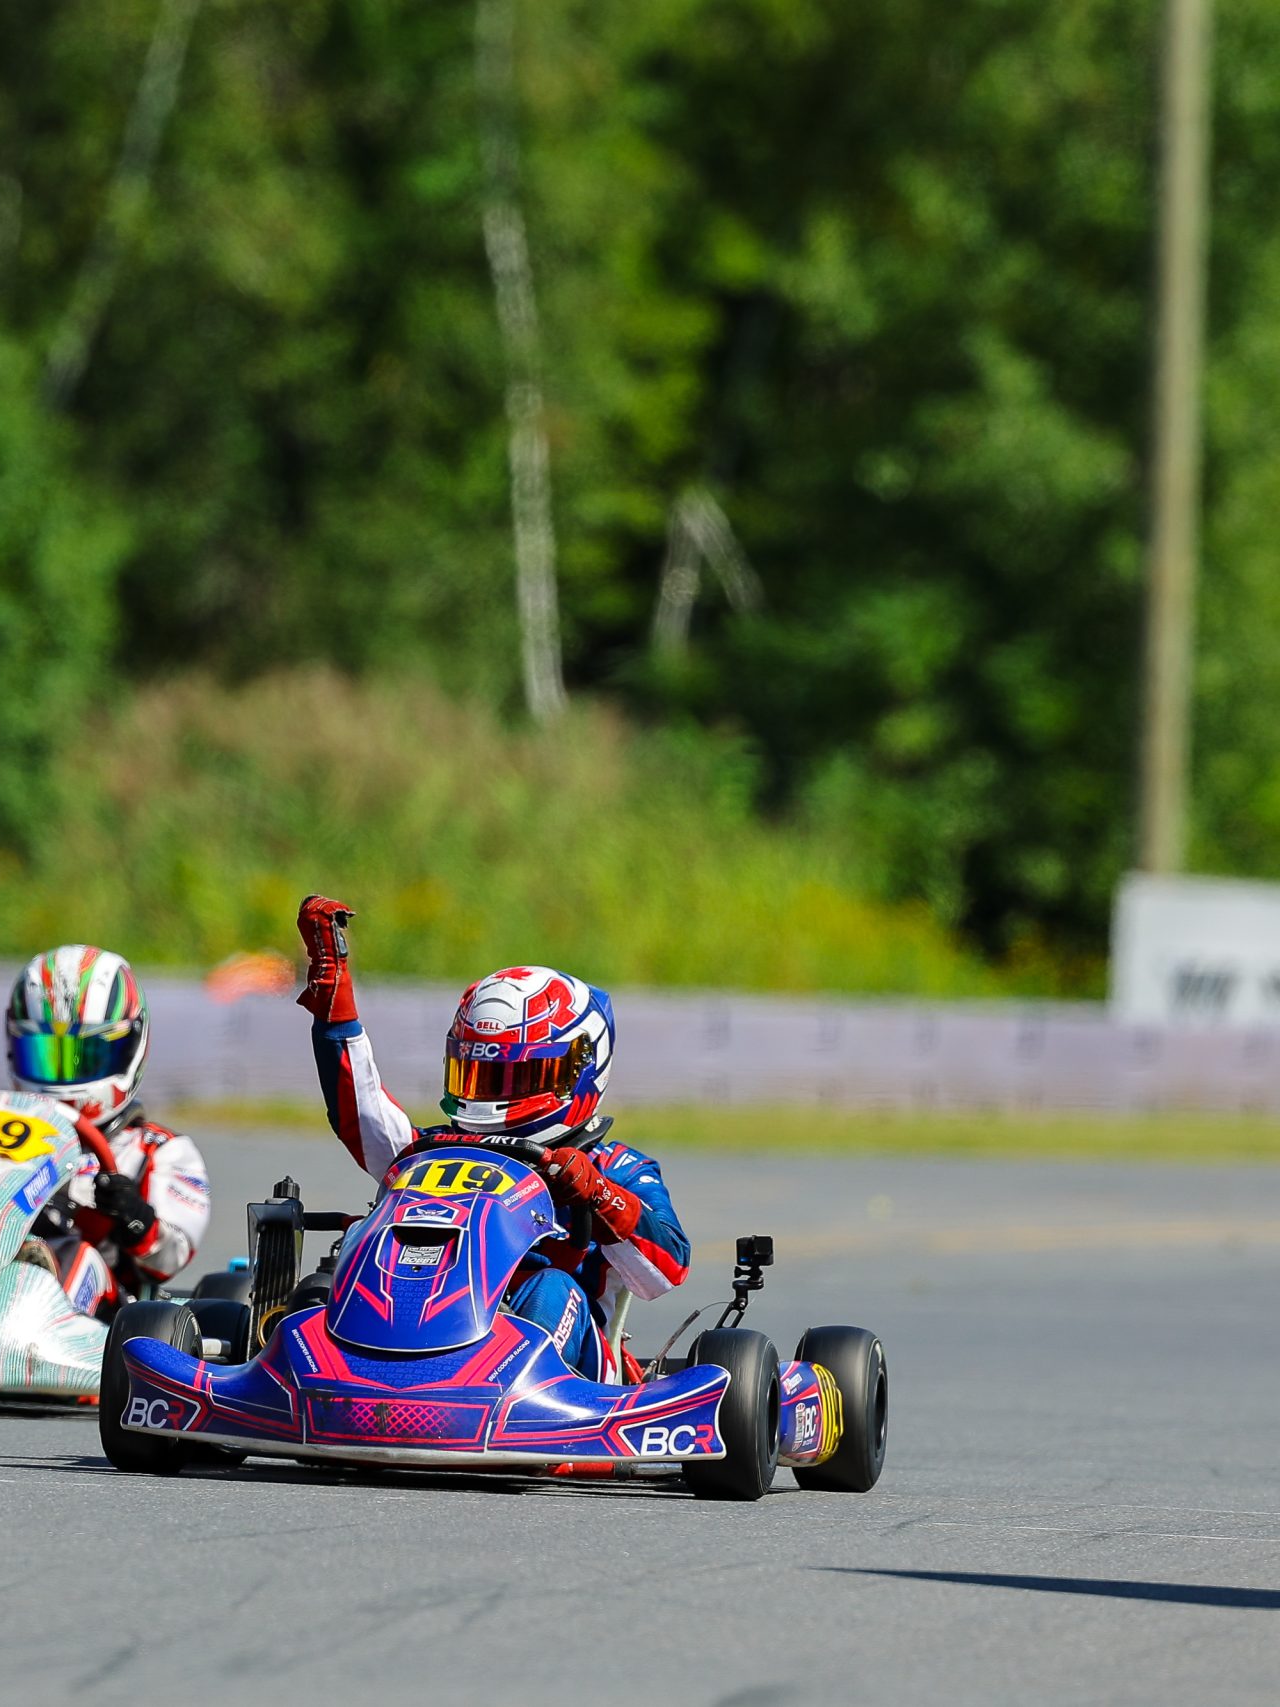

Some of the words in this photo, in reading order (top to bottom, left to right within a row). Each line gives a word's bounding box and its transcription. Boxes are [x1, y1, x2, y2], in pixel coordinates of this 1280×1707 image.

[476, 1021, 502, 1030] BELL
[471, 1042, 511, 1058] BCR
[406, 1161, 505, 1192] 119
[496, 1353, 515, 1372] COOPER
[513, 1338, 530, 1356] RACING
[127, 1397, 185, 1431] BCR
[640, 1423, 714, 1457] BCR
